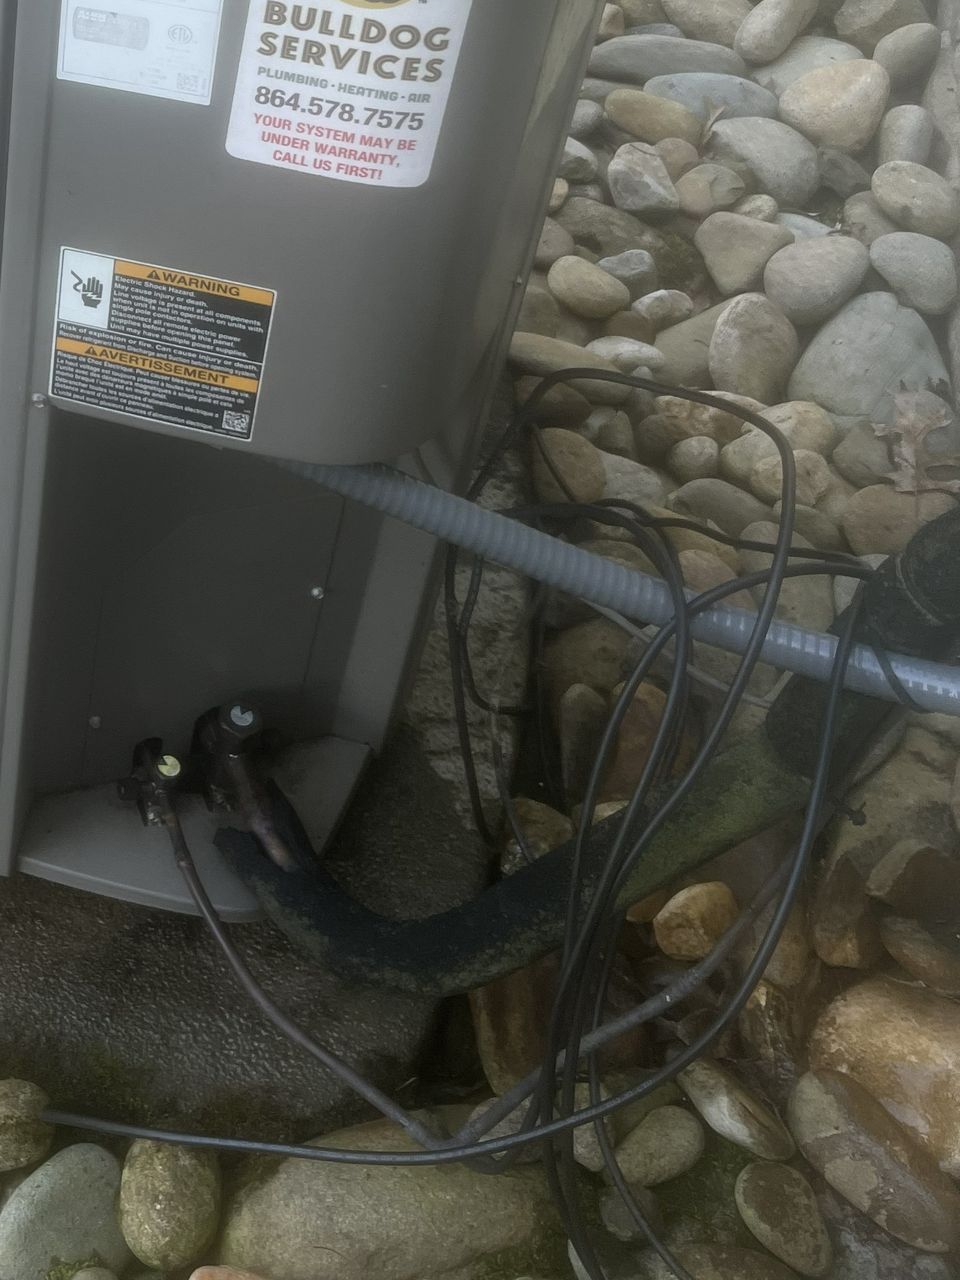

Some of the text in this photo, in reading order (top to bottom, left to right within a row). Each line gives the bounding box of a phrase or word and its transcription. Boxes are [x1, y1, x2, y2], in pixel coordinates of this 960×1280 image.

[263, 0, 450, 51] BULLDOG
[257, 31, 444, 83] SERVICES
[258, 67, 431, 103] PLUMBING HEATING AIR
[255, 86, 424, 131] 864.578.7575
[253, 112, 417, 151] YOUR SYSTEM MAY BE
[261, 130, 401, 168] UNDER WARRANTY,
[273, 150, 383, 180] CALL US FIRST!
[114, 275, 195, 297] Electric Shock Hazard.
[114, 282, 128, 291] May
[130, 287, 152, 295] cause
[153, 291, 174, 301] injury
[185, 298, 208, 307] death.
[161, 271, 240, 296] WARNING
[111, 309, 151, 322] Disconnect
[163, 320, 188, 331] remote
[190, 326, 217, 337] electric
[217, 333, 240, 343] power
[112, 302, 133, 312] single
[135, 307, 151, 316] pole
[112, 296, 132, 305] when
[179, 311, 214, 323] operation
[227, 321, 246, 329] units
[247, 325, 263, 333] with
[113, 290, 129, 298] Line
[130, 293, 157, 305] voltage
[166, 301, 194, 313] present
[214, 311, 261, 327] components
[59, 323, 76, 331] Risk
[88, 329, 126, 343] explosion
[138, 340, 153, 348] fire.
[155, 343, 171, 352] Can
[172, 348, 196, 358] cause
[198, 353, 222, 364] injury
[233, 360, 258, 371] death.
[110, 316, 140, 327] supplies
[142, 322, 165, 332] before
[166, 328, 196, 340] opening
[197, 334, 212, 342] this
[110, 322, 248, 358] Unit may have multiple power supplies.
[59, 330, 81, 339] Recover
[82, 335, 112, 347] refrigerant
[112, 341, 126, 349] from
[126, 344, 155, 357] Discharge
[168, 354, 190, 363] Suction
[190, 359, 209, 367] before
[209, 363, 233, 374] opening
[98, 347, 229, 385] AVERTISSEMENT
